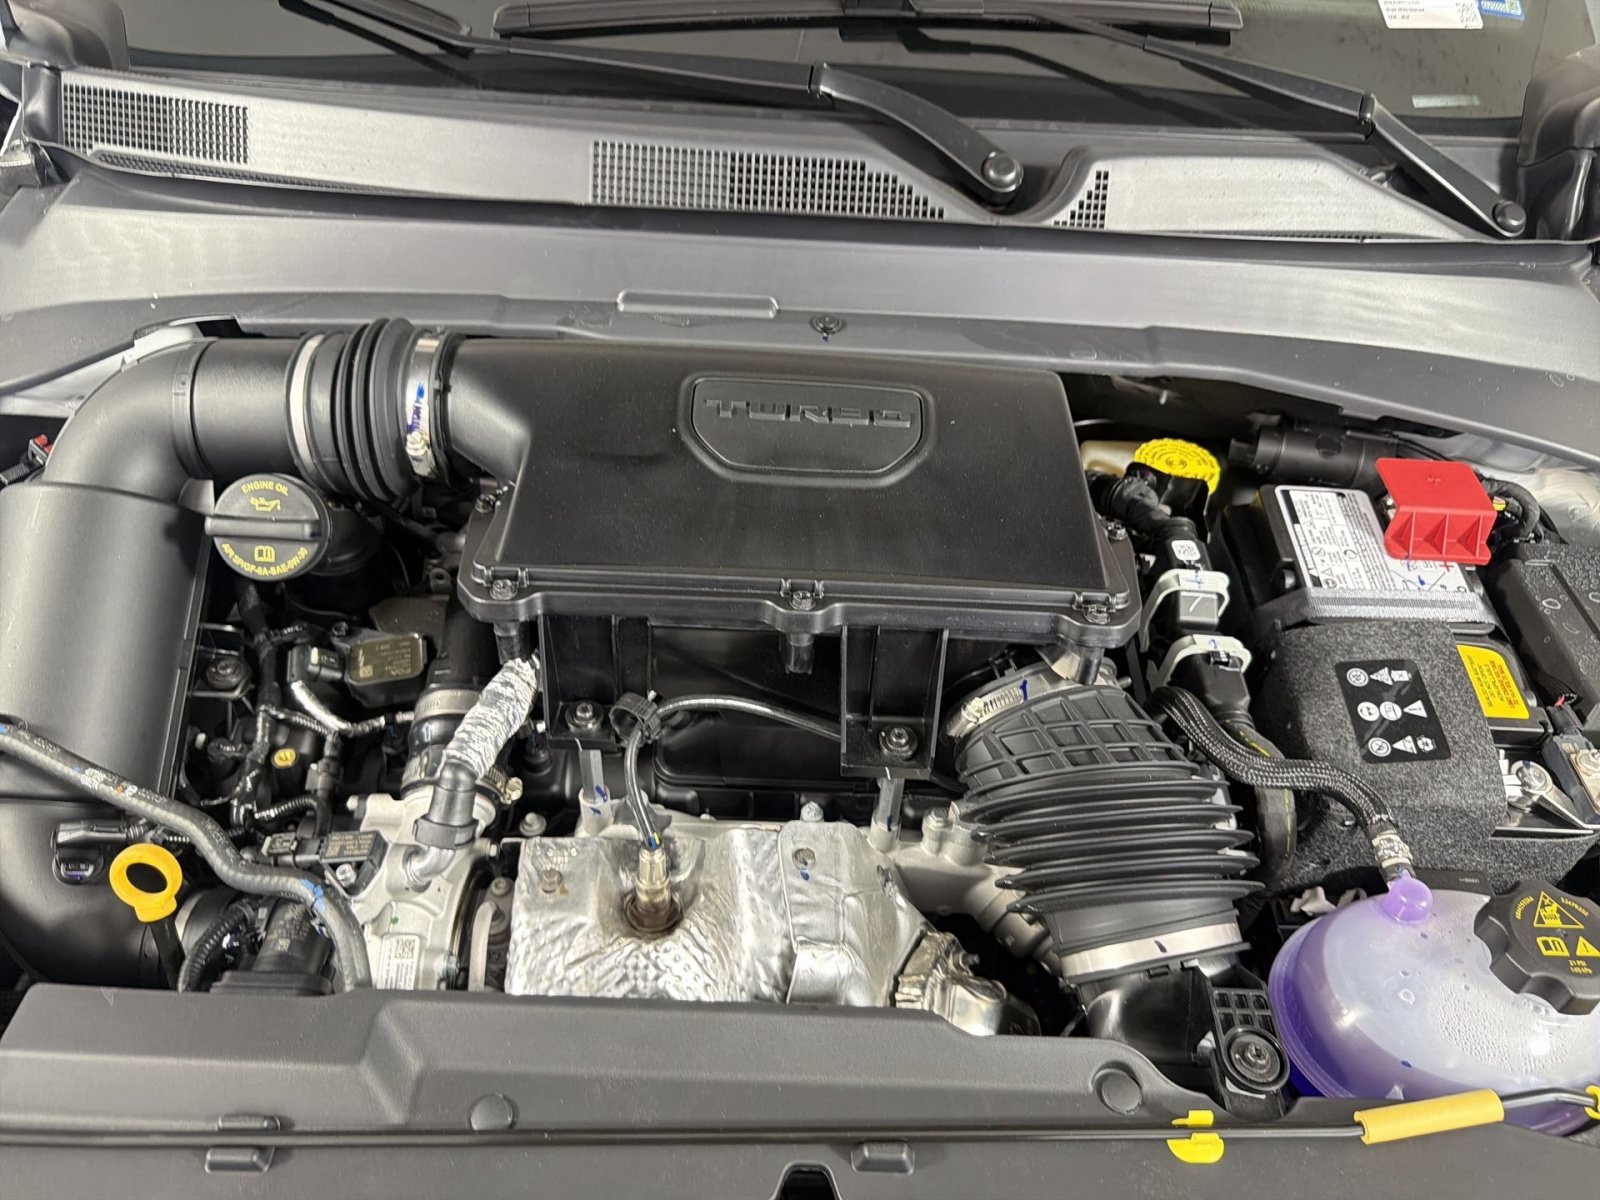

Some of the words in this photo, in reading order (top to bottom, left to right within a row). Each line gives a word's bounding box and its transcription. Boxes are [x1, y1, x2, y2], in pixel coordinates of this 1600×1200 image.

[704, 399, 911, 428] TURBO
[241, 480, 274, 494] ENGINE
[275, 482, 289, 496] OIL
[1576, 959, 1587, 967] PSI
